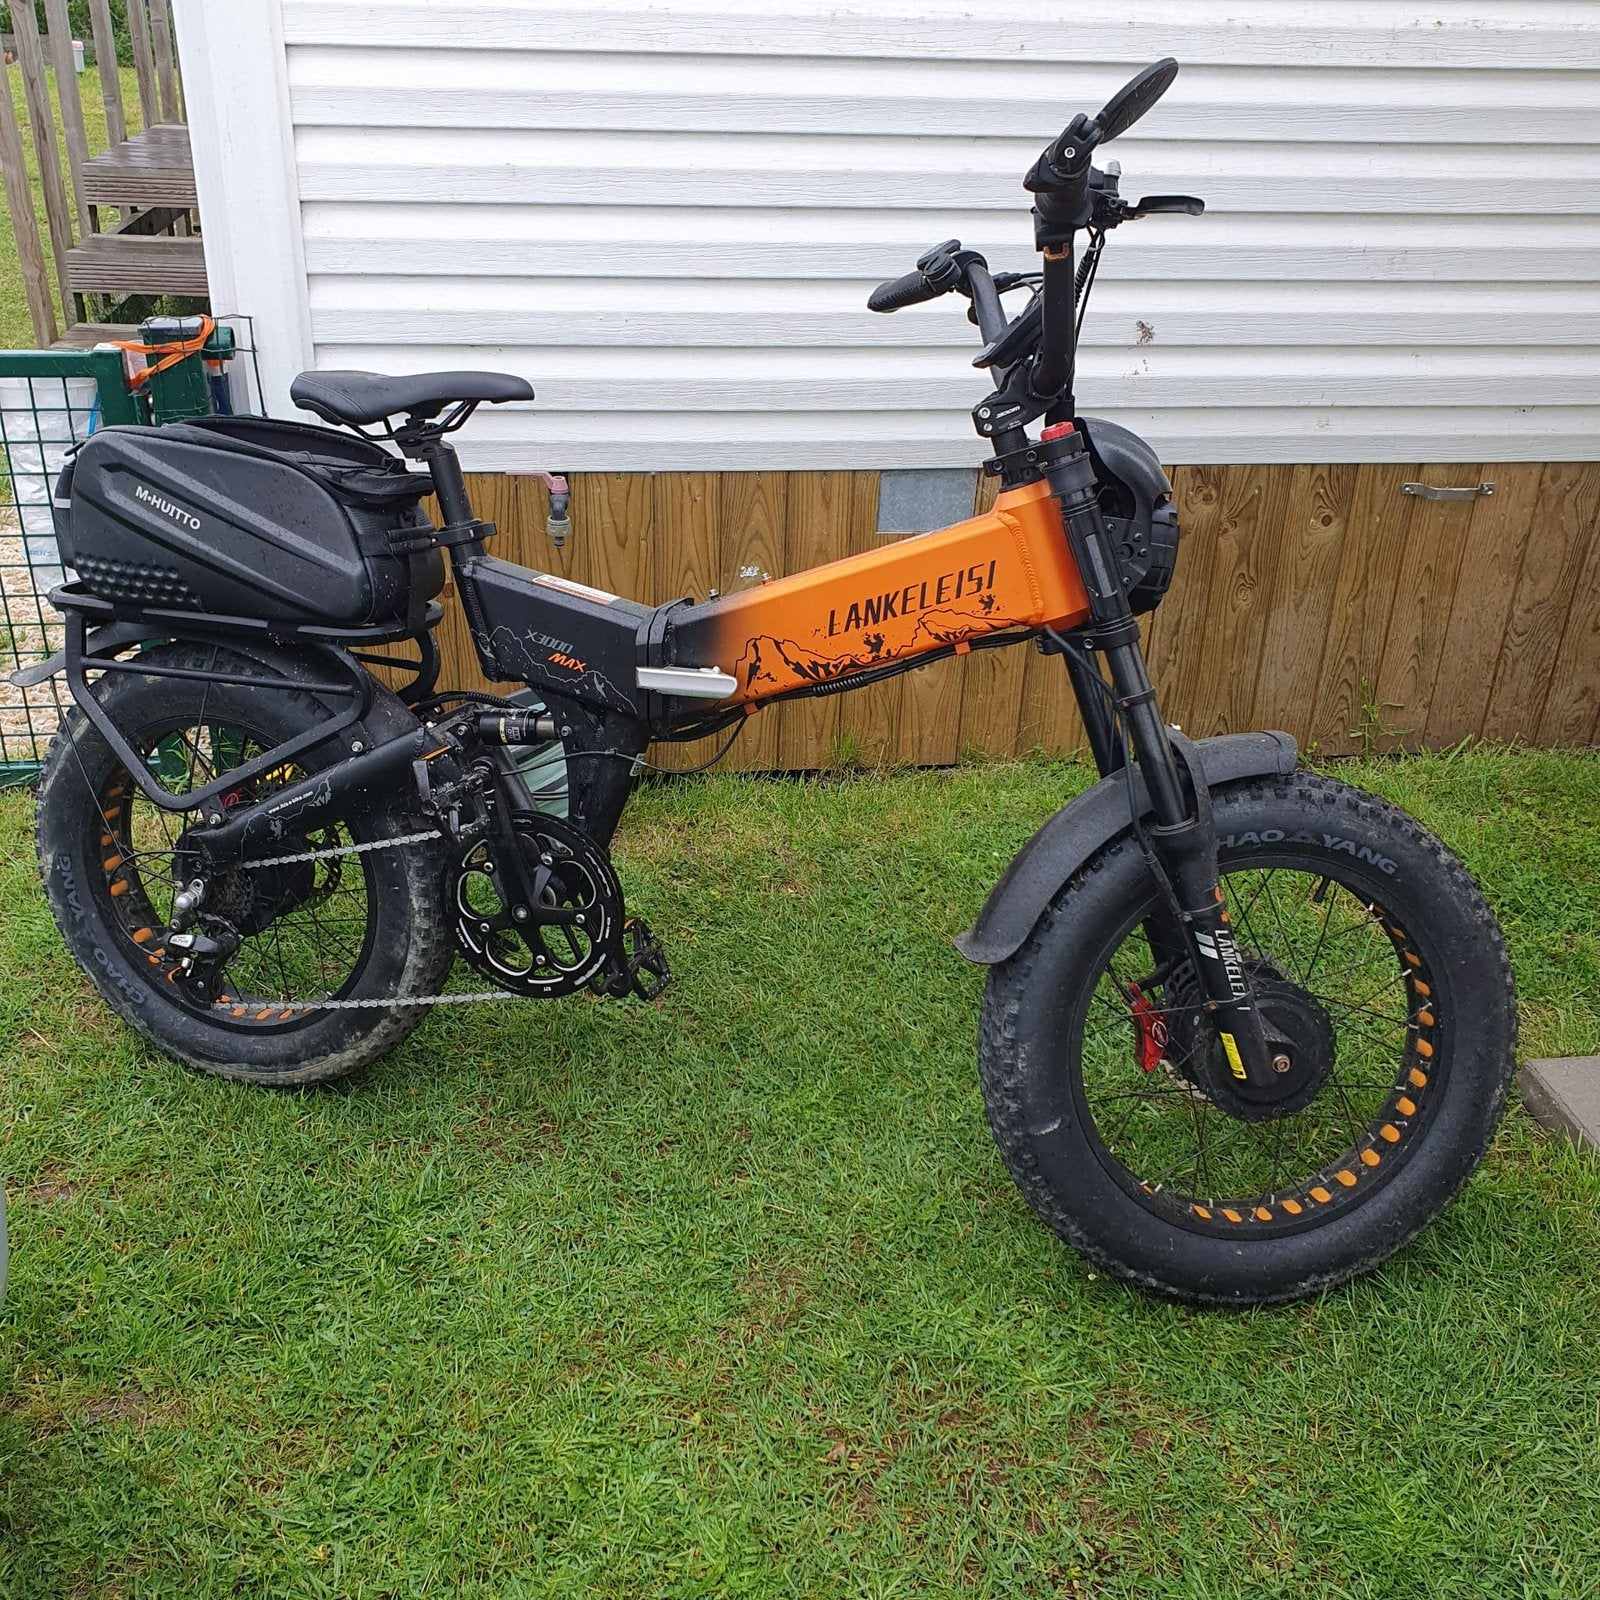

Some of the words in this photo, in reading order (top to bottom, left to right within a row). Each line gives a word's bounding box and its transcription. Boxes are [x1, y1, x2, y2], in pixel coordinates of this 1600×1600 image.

[828, 560, 996, 637] LANKELEISI
[524, 629, 574, 654] X3000
[547, 652, 587, 673] MAX
[1322, 833, 1399, 876] YANG
[59, 854, 86, 923] YANG
[93, 947, 146, 1005] CHAO
